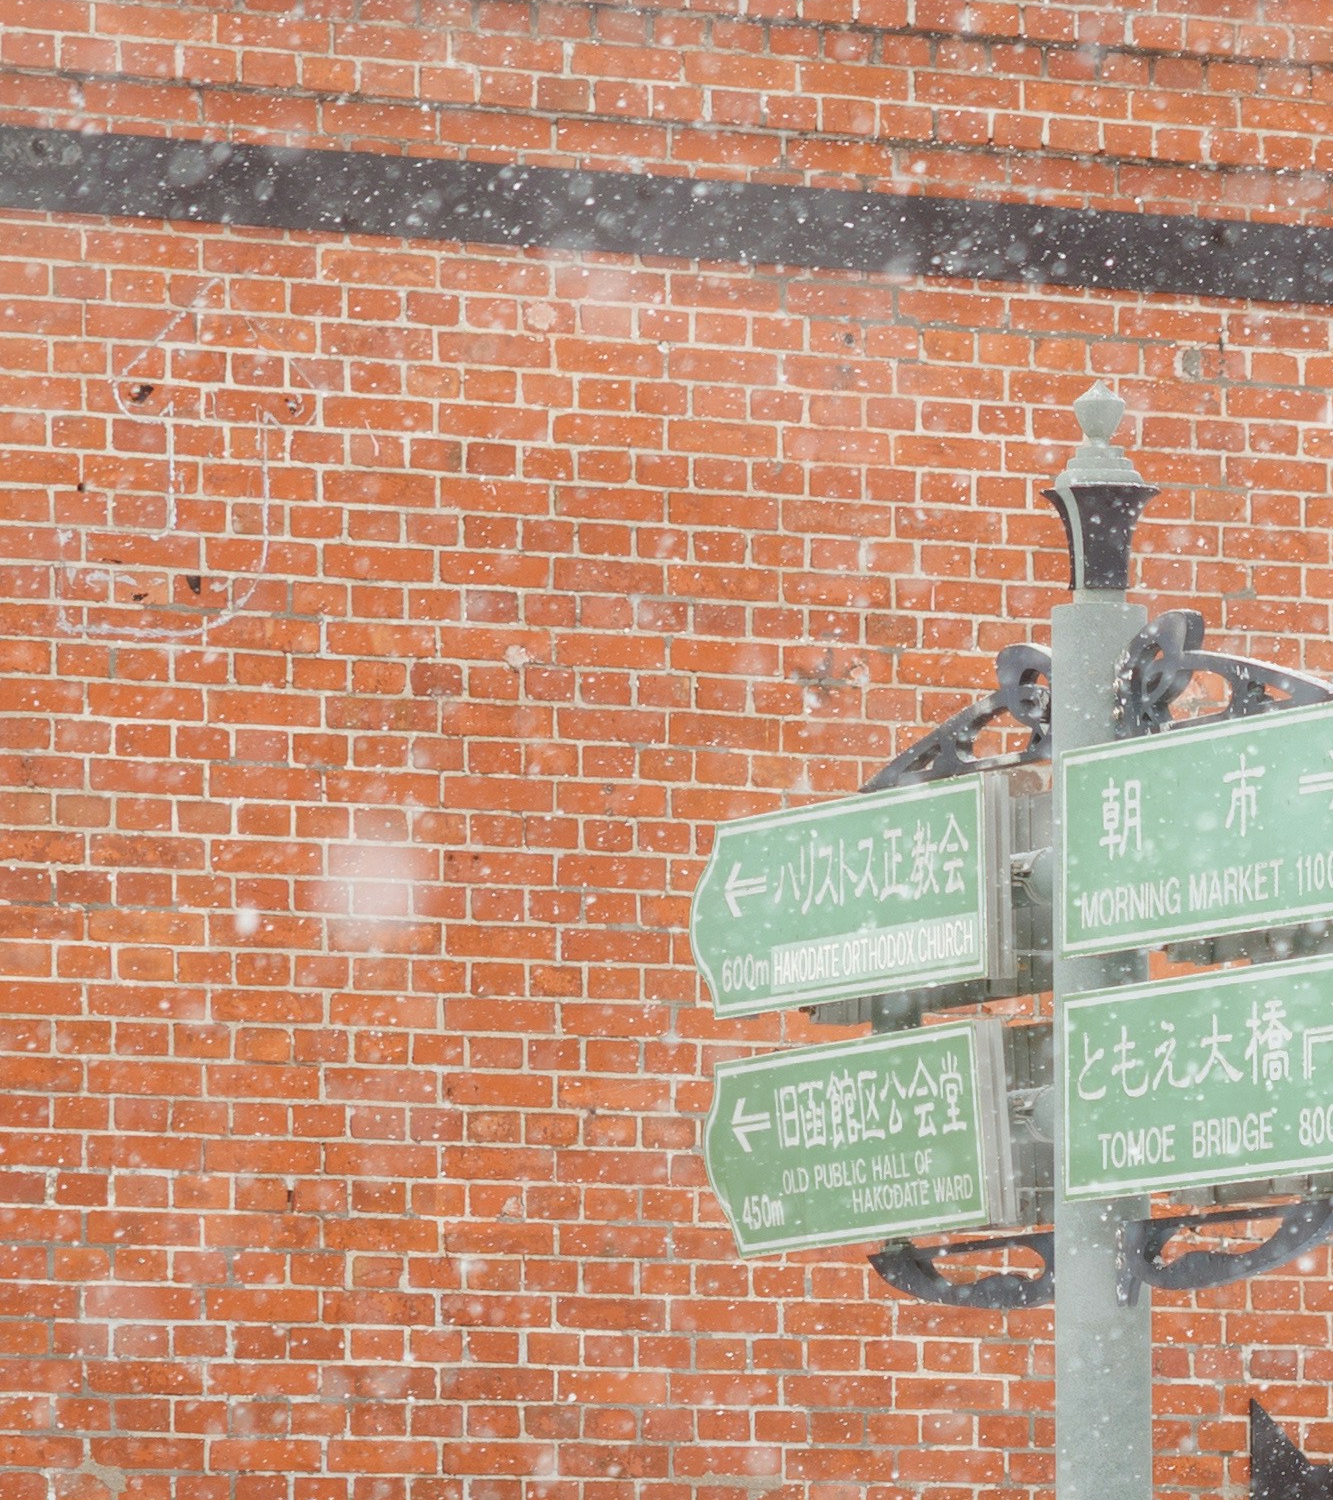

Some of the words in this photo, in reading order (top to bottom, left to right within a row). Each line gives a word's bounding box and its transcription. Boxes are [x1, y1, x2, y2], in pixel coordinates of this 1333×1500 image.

[774, 812, 969, 915] ハリストス正教会
[1080, 876, 1182, 929] MORNING
[1188, 858, 1284, 911] MARKET
[721, 953, 770, 992] 600m
[773, 943, 840, 986] HAKODATE
[842, 931, 916, 975] ORTHODOX
[918, 919, 973, 962] CHURCH
[1077, 999, 1293, 1101] ともえ大橋
[773, 1050, 967, 1149] 旧函館区公会堂
[782, 1167, 810, 1195] OLD
[815, 1158, 867, 1190] PUBLIC
[872, 1153, 910, 1181] HALL
[914, 1148, 933, 1175] OF
[1097, 1124, 1176, 1170] TOMOE
[1192, 1111, 1273, 1159] BRIDGE
[742, 1194, 785, 1231] 450m
[852, 1180, 930, 1214] HAKODATE
[932, 1173, 974, 1202] WARD
